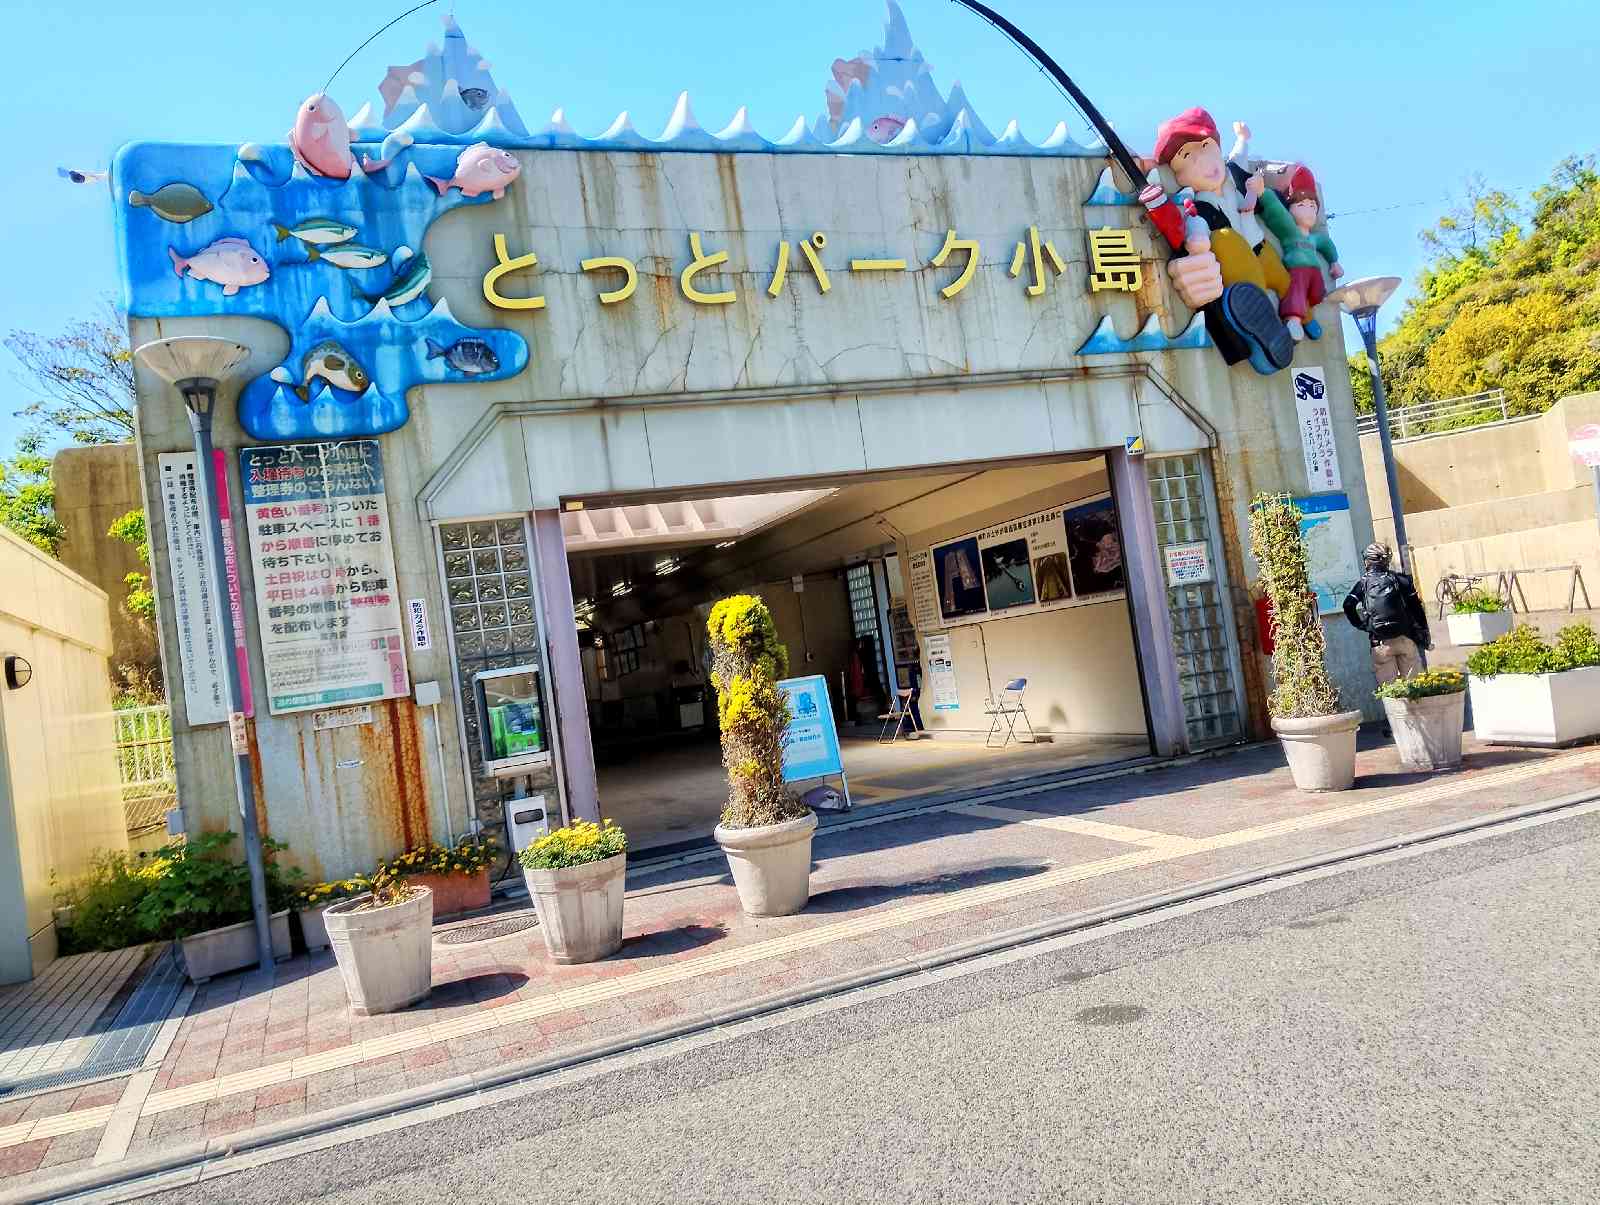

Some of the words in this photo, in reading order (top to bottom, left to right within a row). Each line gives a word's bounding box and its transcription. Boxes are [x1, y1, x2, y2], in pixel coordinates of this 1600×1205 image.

[483, 225, 1143, 310] とっとパーク小島
[256, 500, 378, 520] 黄色い番号がついた
[261, 531, 382, 553] から順番に停めてお
